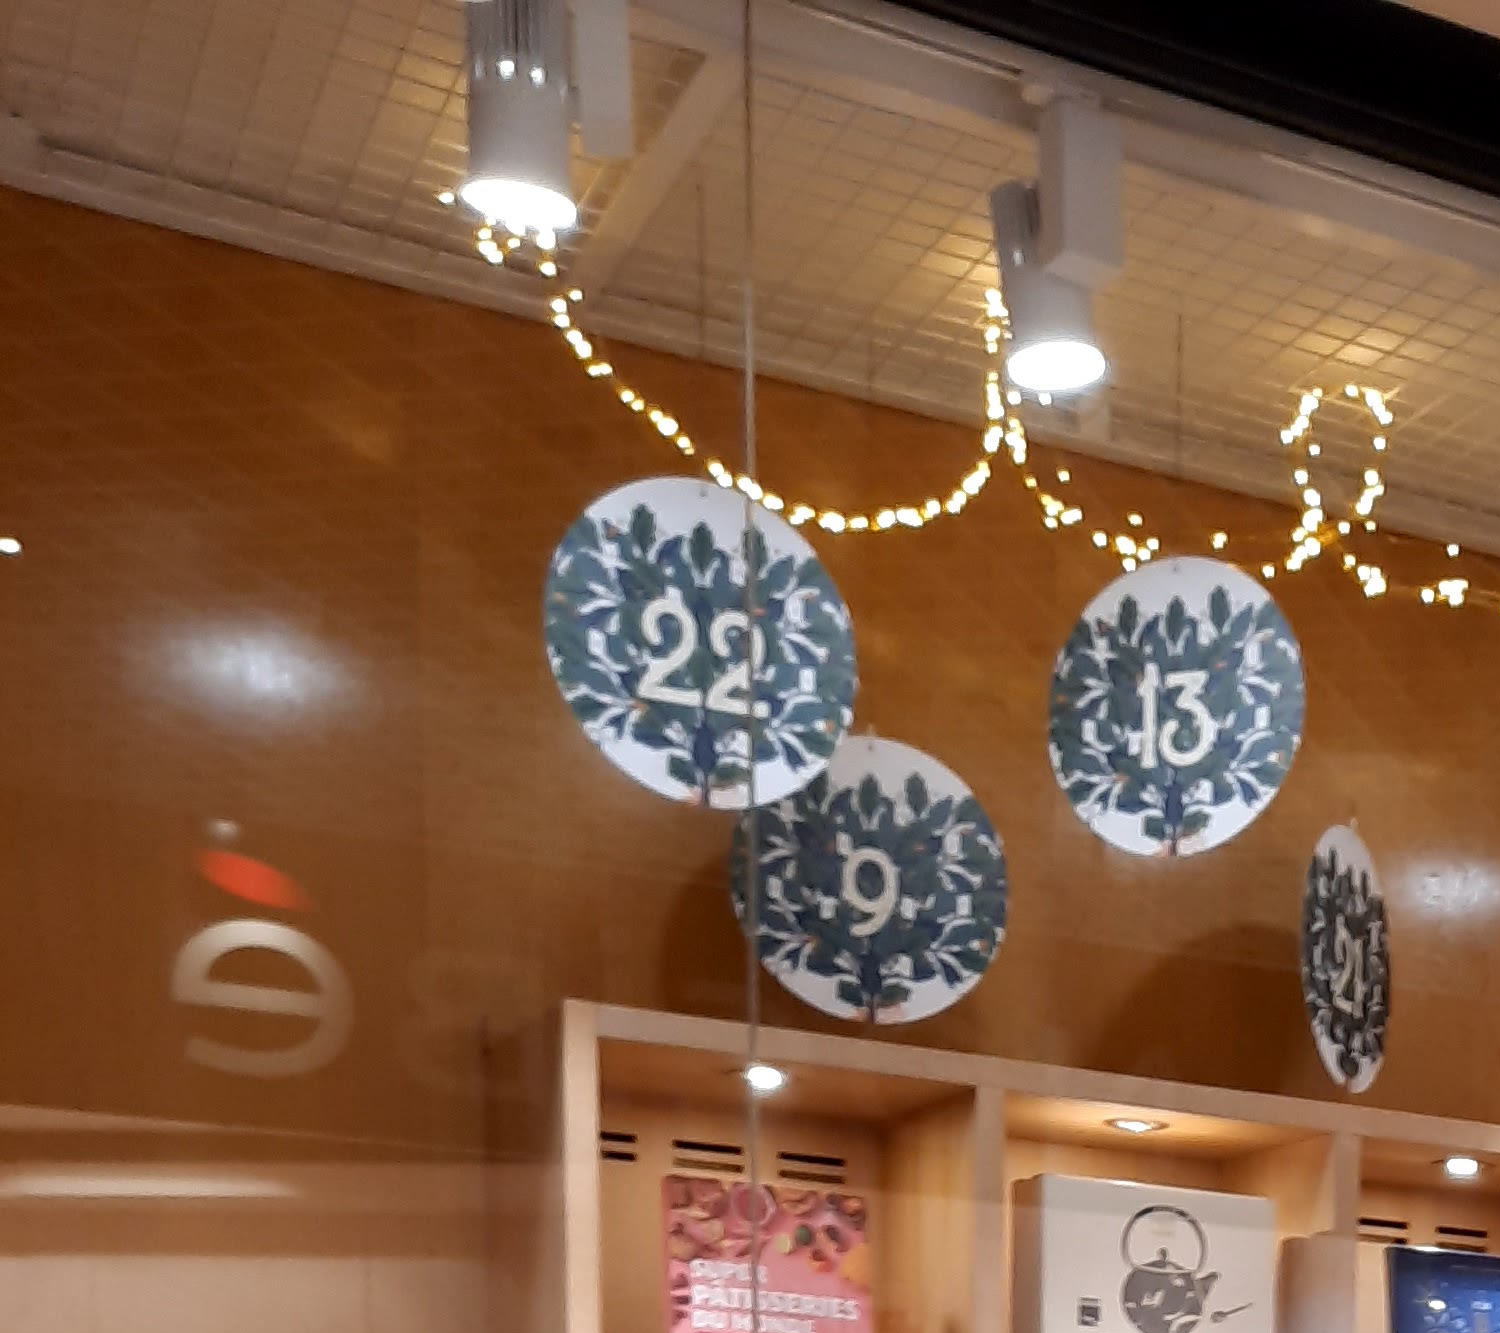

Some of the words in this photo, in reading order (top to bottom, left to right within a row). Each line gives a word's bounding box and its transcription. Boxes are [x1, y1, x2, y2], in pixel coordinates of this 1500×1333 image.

[637, 598, 768, 717] 22
[1136, 660, 1221, 769] 13
[847, 848, 901, 937] 9
